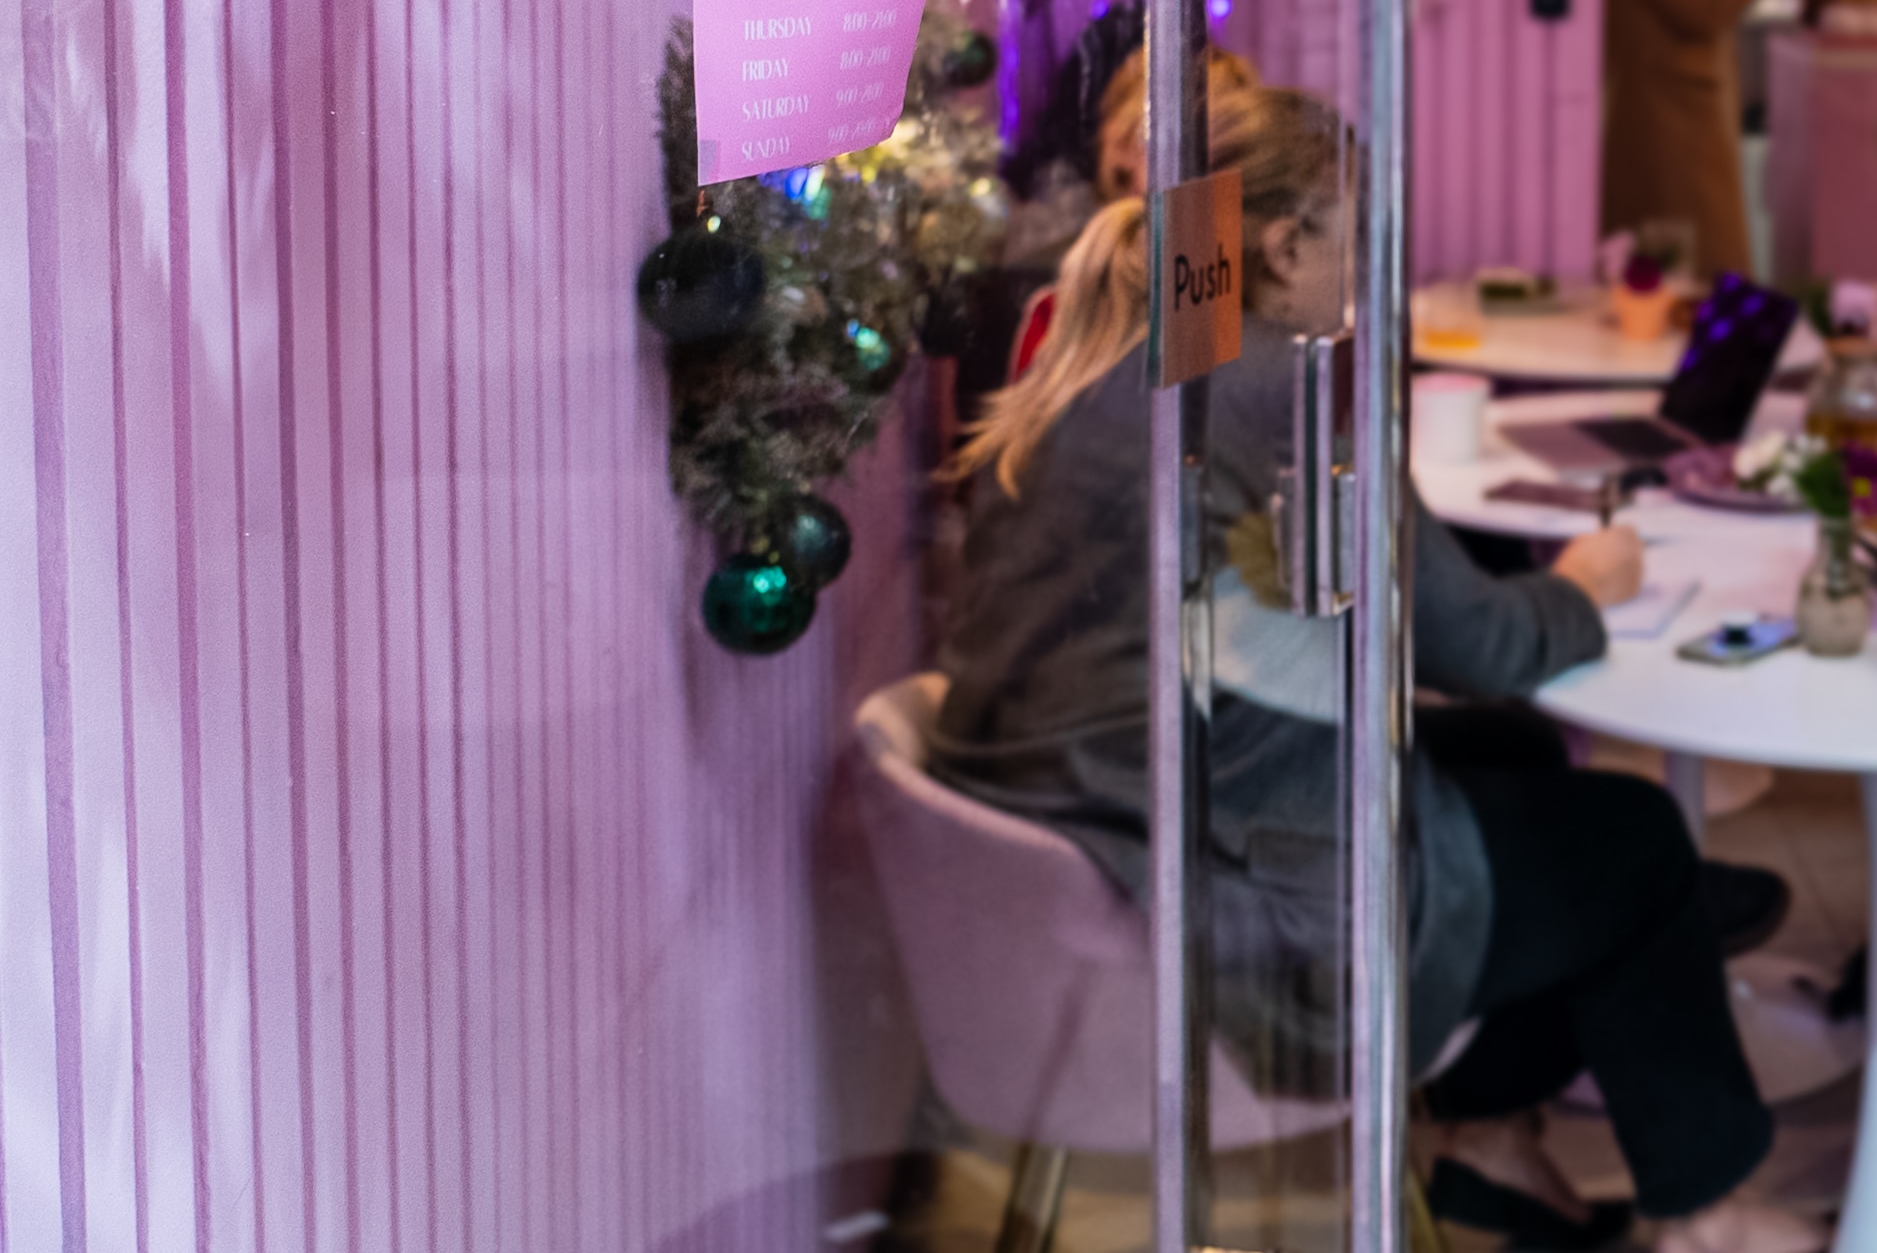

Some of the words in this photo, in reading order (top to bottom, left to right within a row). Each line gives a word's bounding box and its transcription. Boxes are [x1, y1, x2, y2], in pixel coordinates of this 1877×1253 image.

[744, 15, 812, 41] THURSDAY
[742, 58, 789, 82] FRIDAY
[742, 94, 809, 122] SATURDAY
[741, 133, 790, 162] SUNDAY
[1174, 245, 1231, 312] Push
